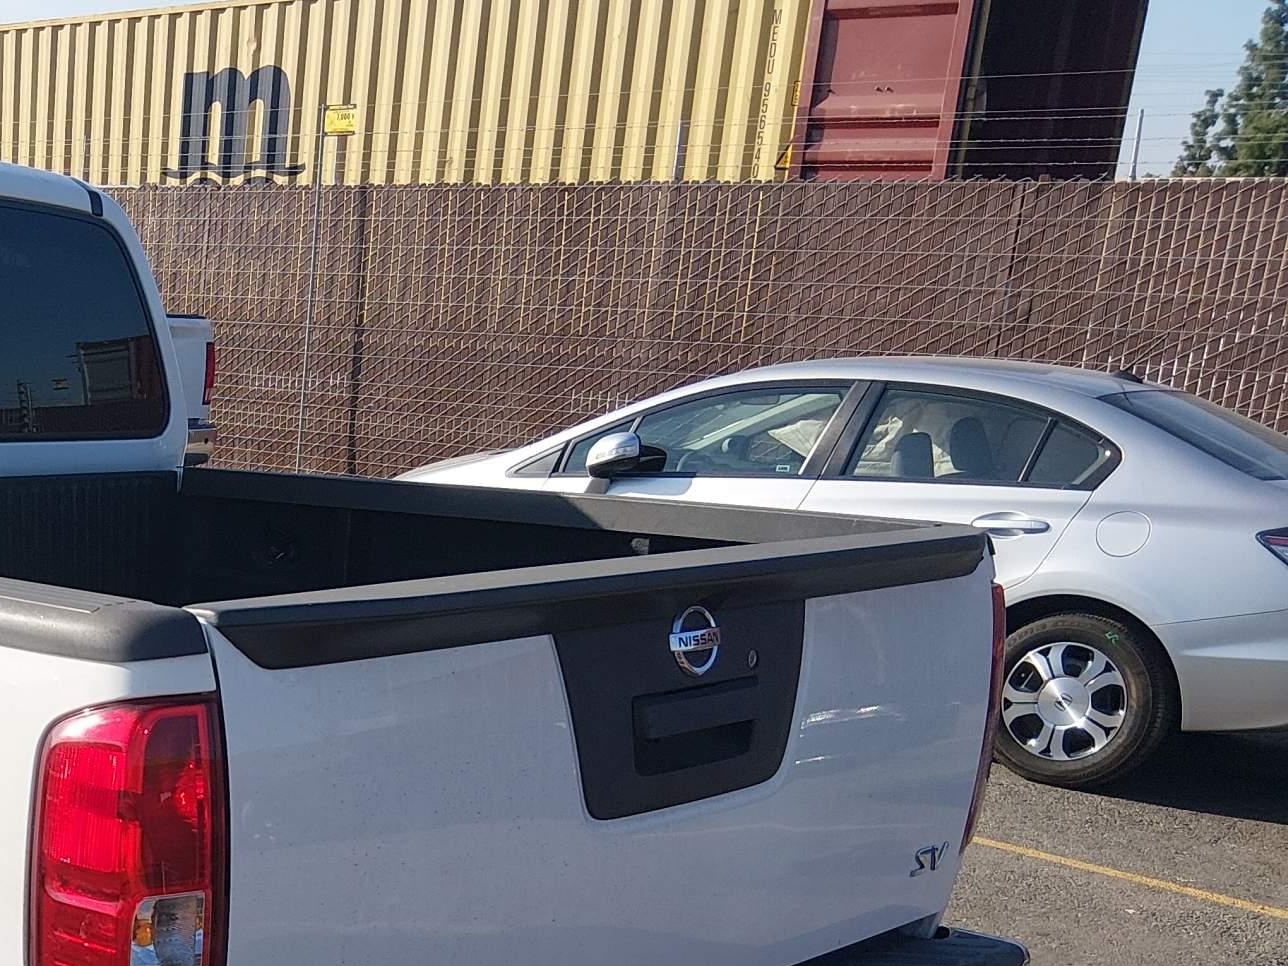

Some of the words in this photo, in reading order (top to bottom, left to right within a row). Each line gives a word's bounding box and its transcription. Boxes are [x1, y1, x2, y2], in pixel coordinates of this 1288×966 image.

[767, 8, 783, 75] MEDU
[677, 630, 720, 649] NISSAN
[909, 841, 950, 878] SV
